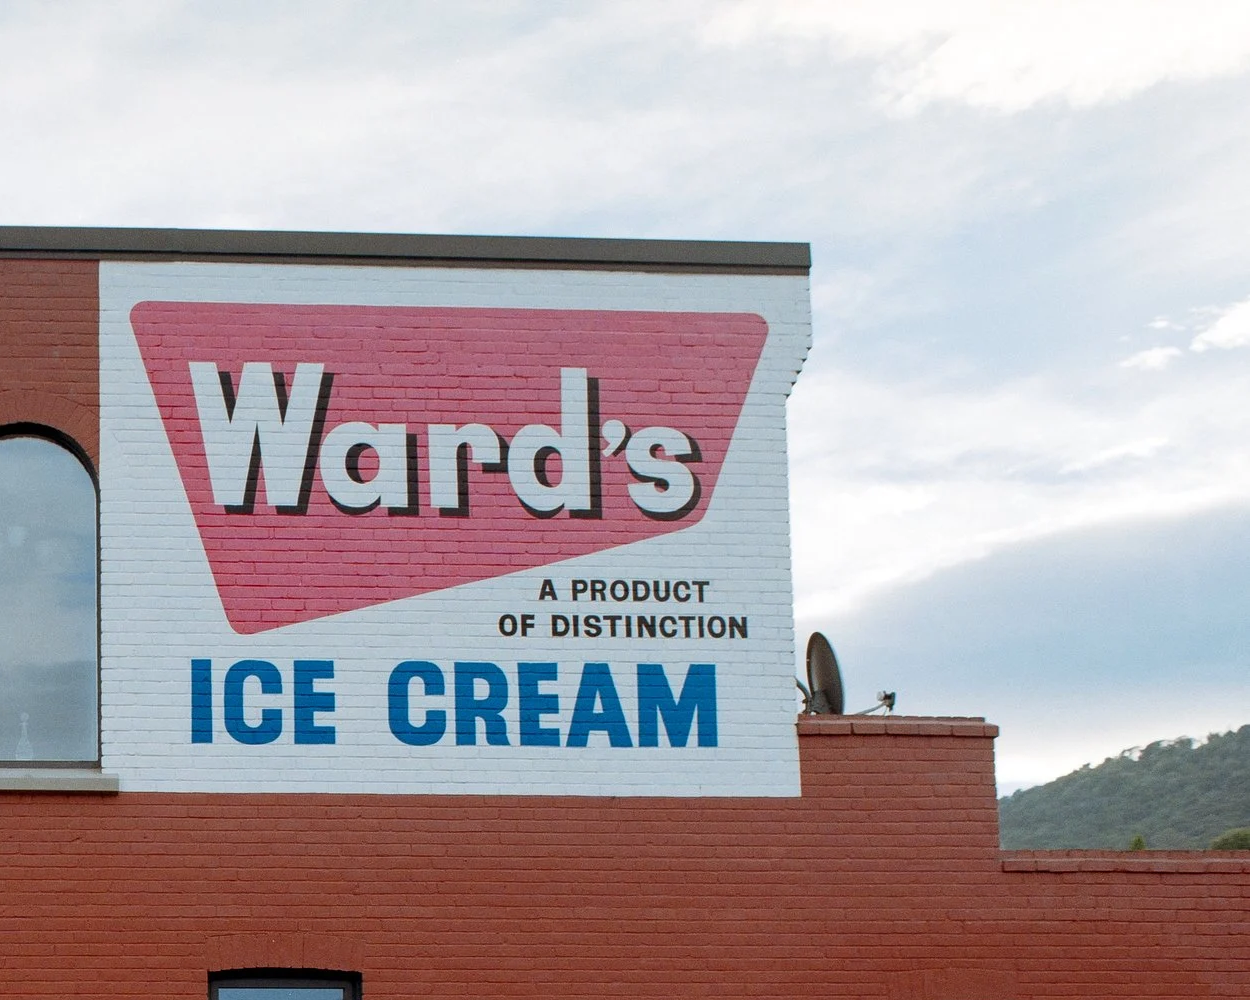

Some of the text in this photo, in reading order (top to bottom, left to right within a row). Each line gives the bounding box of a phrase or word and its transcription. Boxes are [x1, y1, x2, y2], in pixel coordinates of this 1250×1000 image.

[188, 361, 702, 521] Ward's
[538, 579, 710, 603] A PRODUCT
[498, 614, 748, 640] OF DISTINCTION
[190, 658, 719, 748] ICE CREAM
